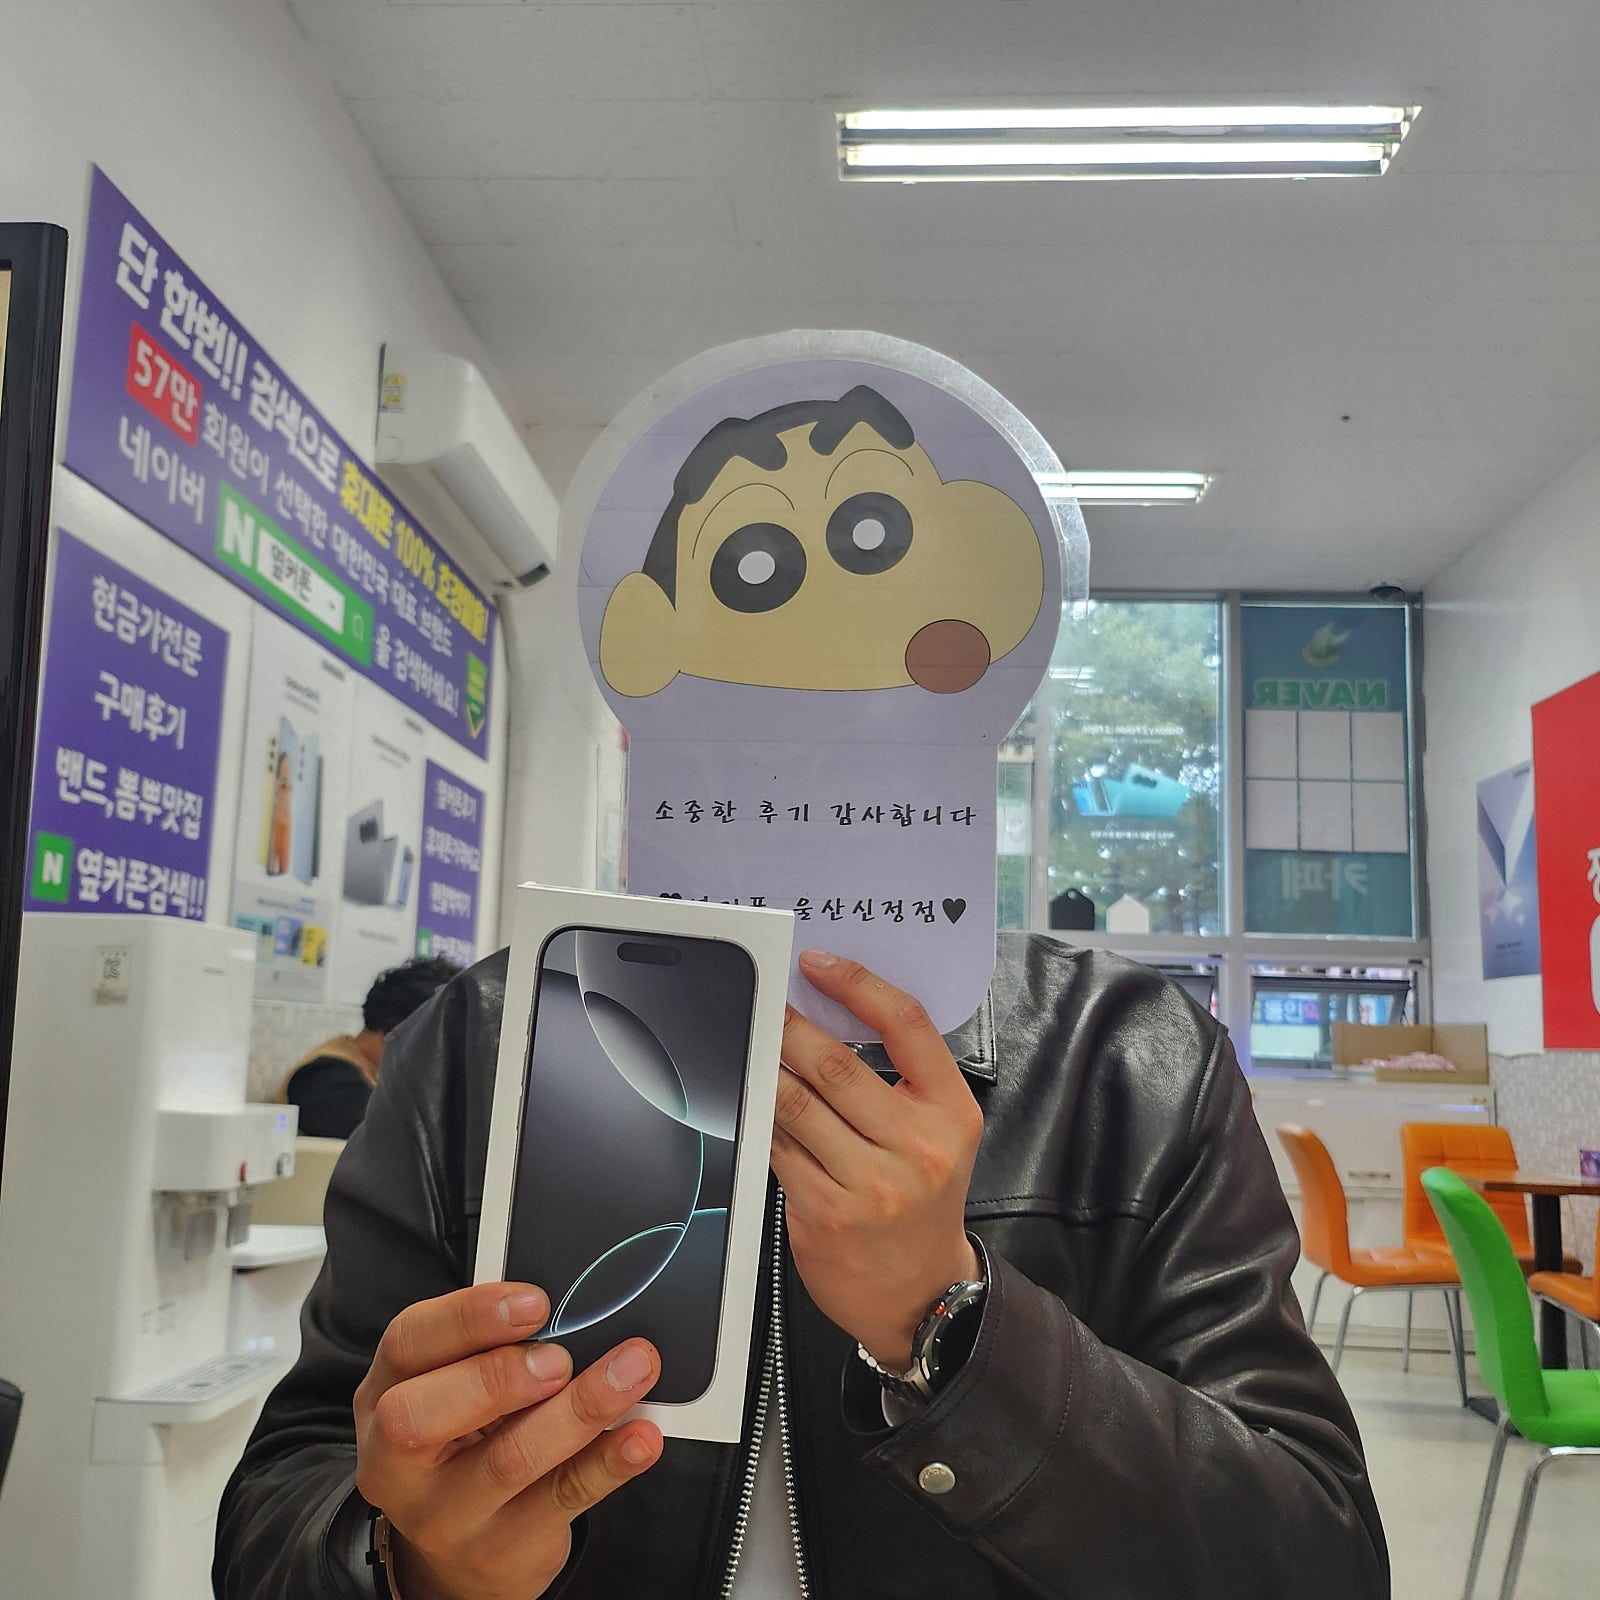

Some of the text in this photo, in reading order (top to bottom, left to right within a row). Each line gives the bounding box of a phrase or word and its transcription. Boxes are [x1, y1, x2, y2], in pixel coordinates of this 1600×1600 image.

[116, 222, 158, 309] 단
[160, 269, 248, 400] 한번!!
[248, 360, 341, 494] 검색으로
[341, 459, 395, 549] 휴대폰
[396, 520, 435, 591] 100%
[119, 415, 206, 525] 네이버
[222, 497, 256, 568] N
[271, 544, 313, 602] 옆커폰
[375, 622, 392, 670] 을
[134, 338, 198, 433] 57만
[202, 401, 270, 496] 회원이
[275, 470, 328, 550] 선택한
[332, 523, 389, 606] 대한민국
[418, 605, 453, 658] 브랜드
[92, 574, 203, 678] 현금가전문
[94, 669, 187, 750] 구매후기
[655, 799, 977, 827] 소중한 후기 감사합니다
[41, 848, 206, 919] N 옆커폰검색!!
[793, 897, 935, 924] 울산신정점
